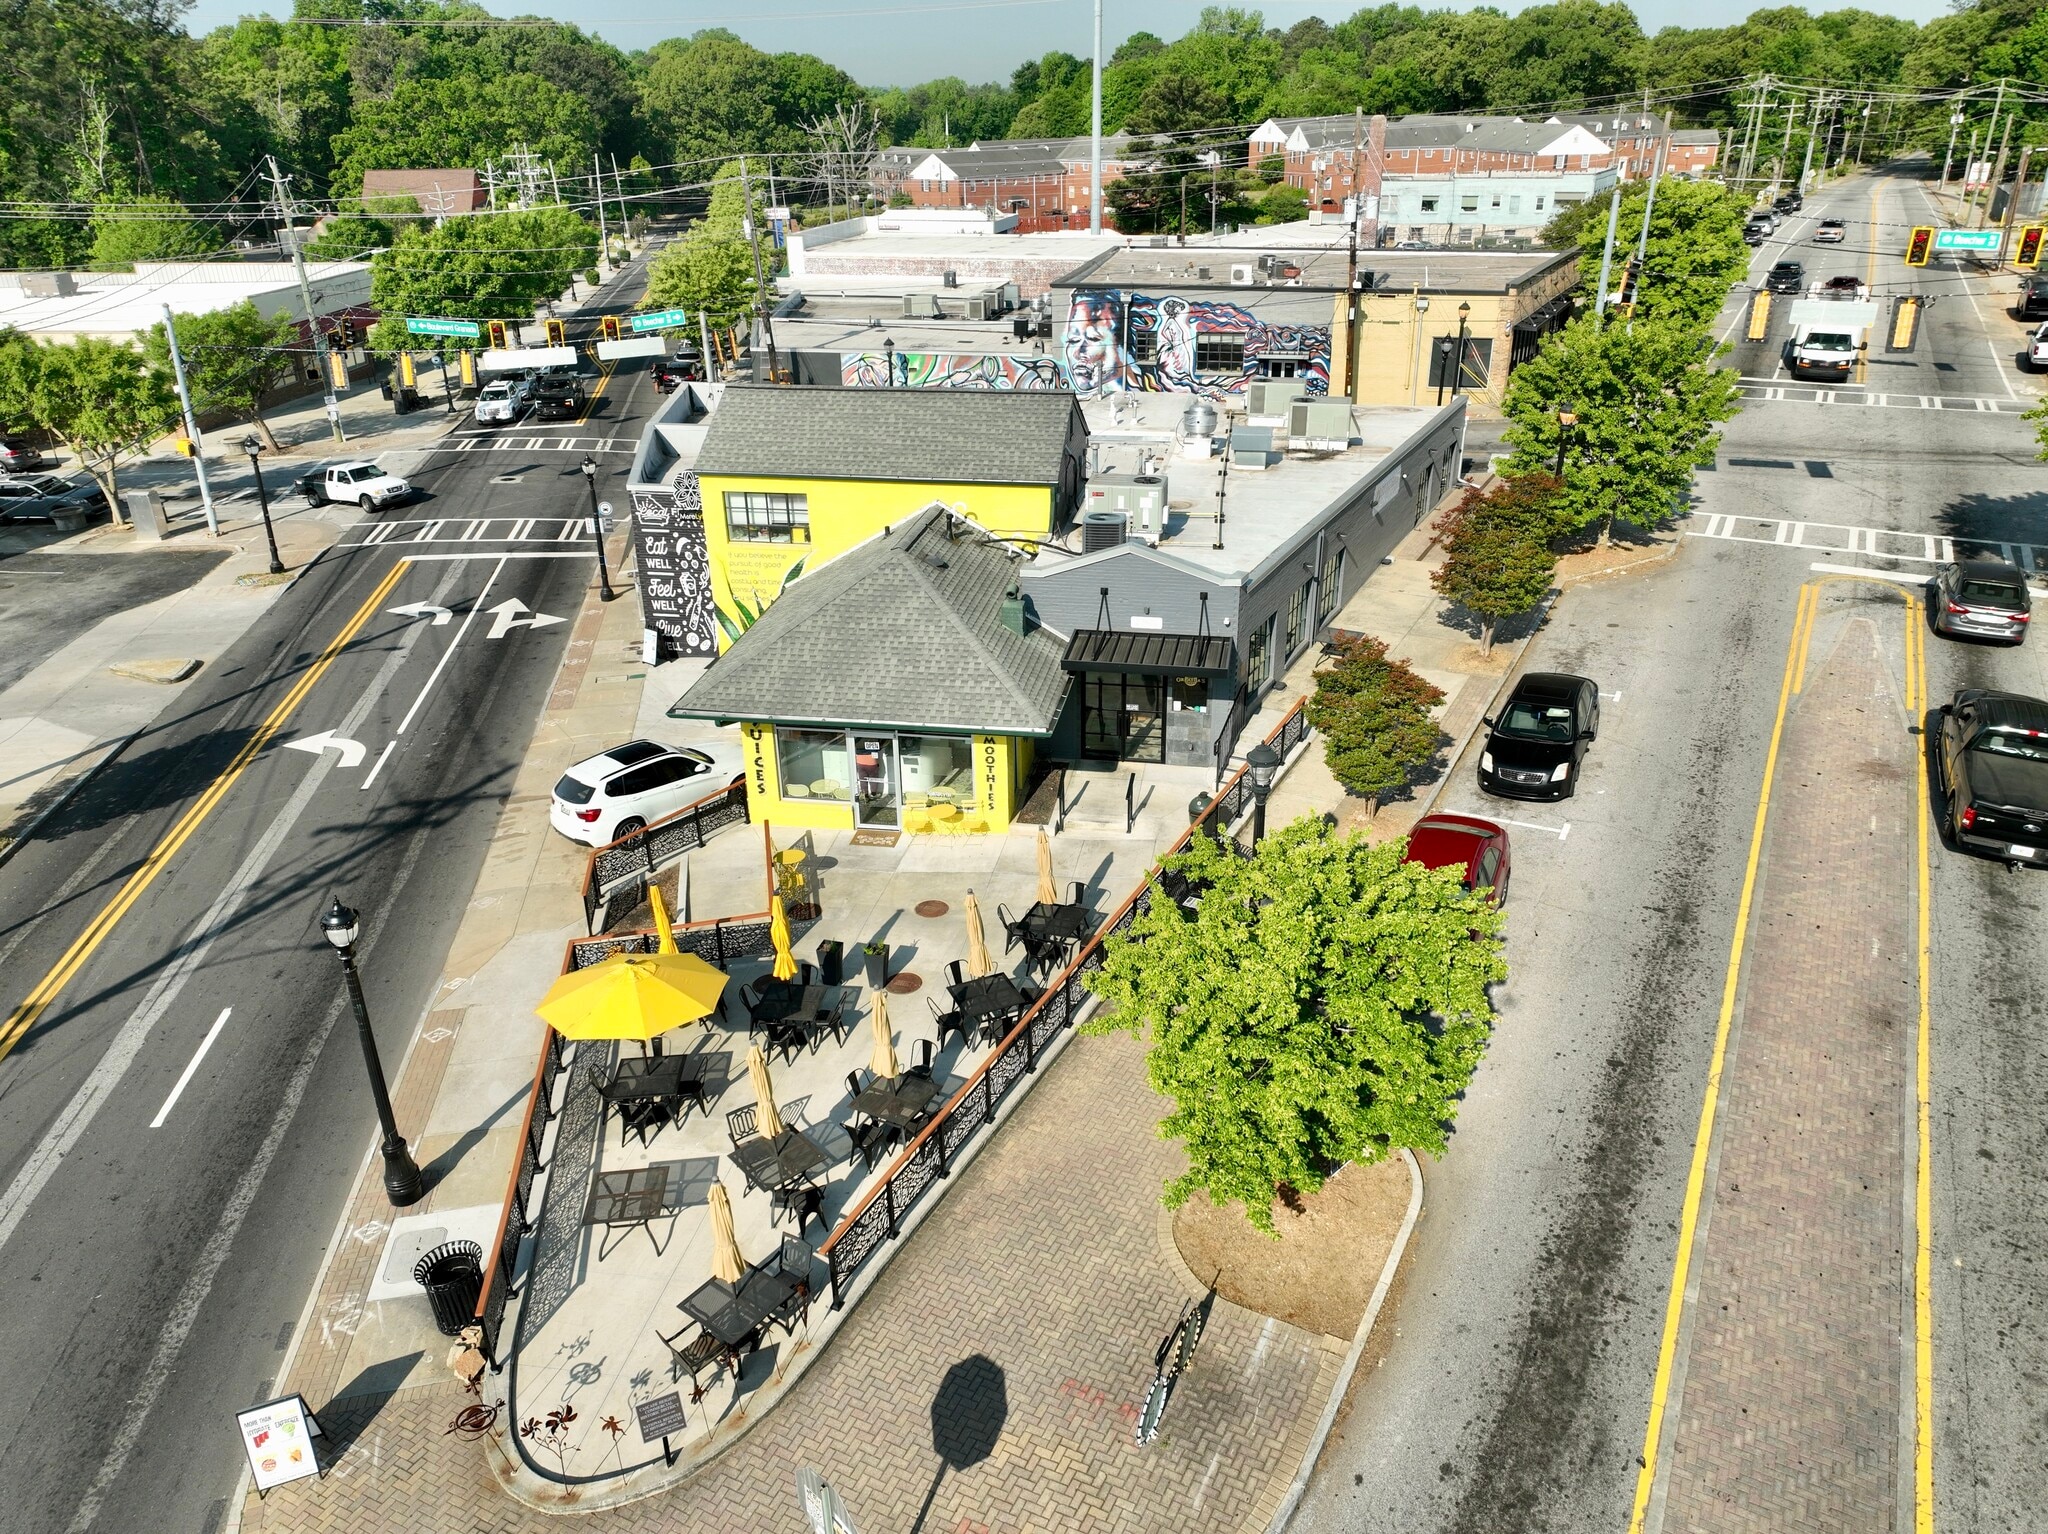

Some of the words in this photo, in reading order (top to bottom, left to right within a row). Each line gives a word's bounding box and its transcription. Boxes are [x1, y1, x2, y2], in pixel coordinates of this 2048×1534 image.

[642, 317, 664, 326] Beecher
[645, 536, 668, 555] Eat
[646, 558, 672, 569] WELL
[648, 579, 676, 597] Feel
[651, 600, 677, 610] WELL
[665, 642, 683, 651] ELL
[750, 722, 766, 794] UICES
